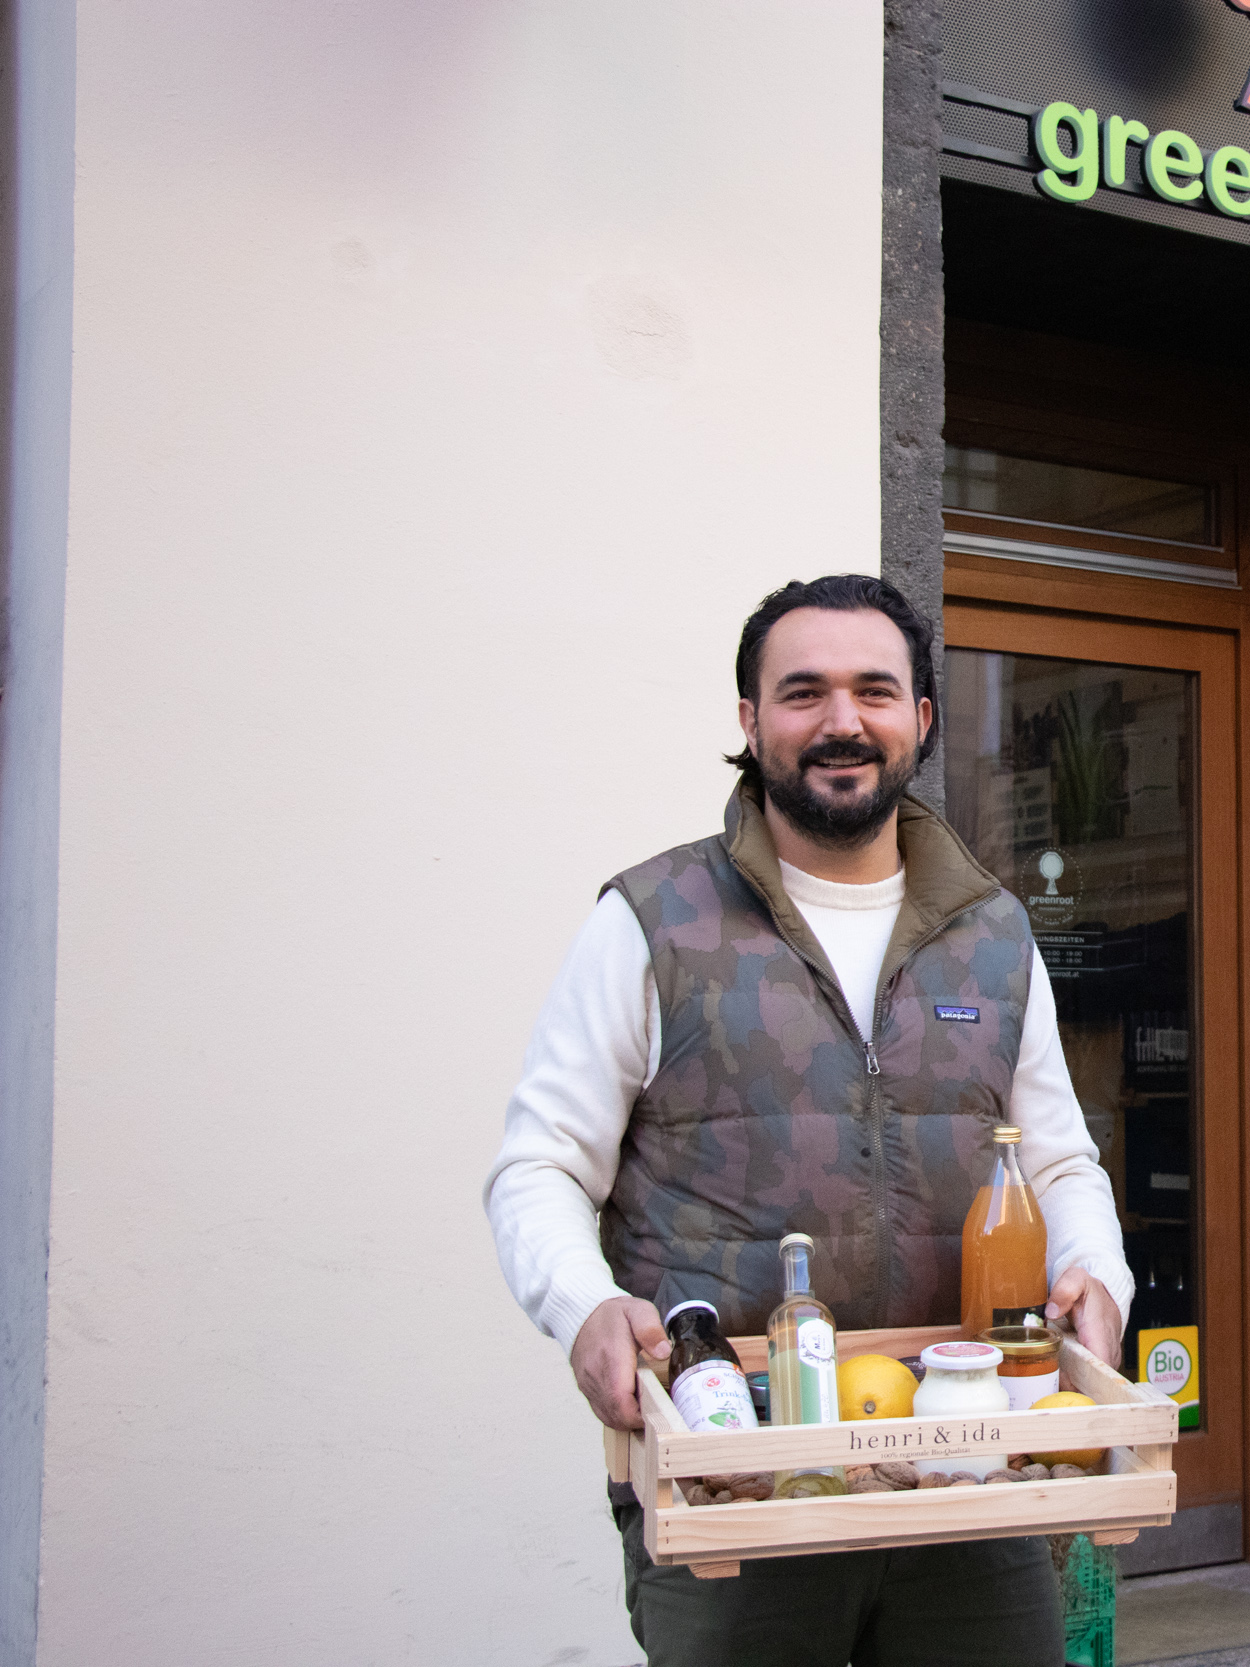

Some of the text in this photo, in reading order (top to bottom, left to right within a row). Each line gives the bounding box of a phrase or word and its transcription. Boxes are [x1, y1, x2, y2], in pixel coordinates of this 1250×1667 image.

[1029, 896, 1074, 905] greenroot
[1155, 1350, 1184, 1373] Bio
[1154, 1373, 1185, 1383] AUSTRIA
[850, 1422, 1001, 1450] henri & ida
[899, 1450, 930, 1459] regionale
[931, 1447, 971, 1456] Bio-Qualität
